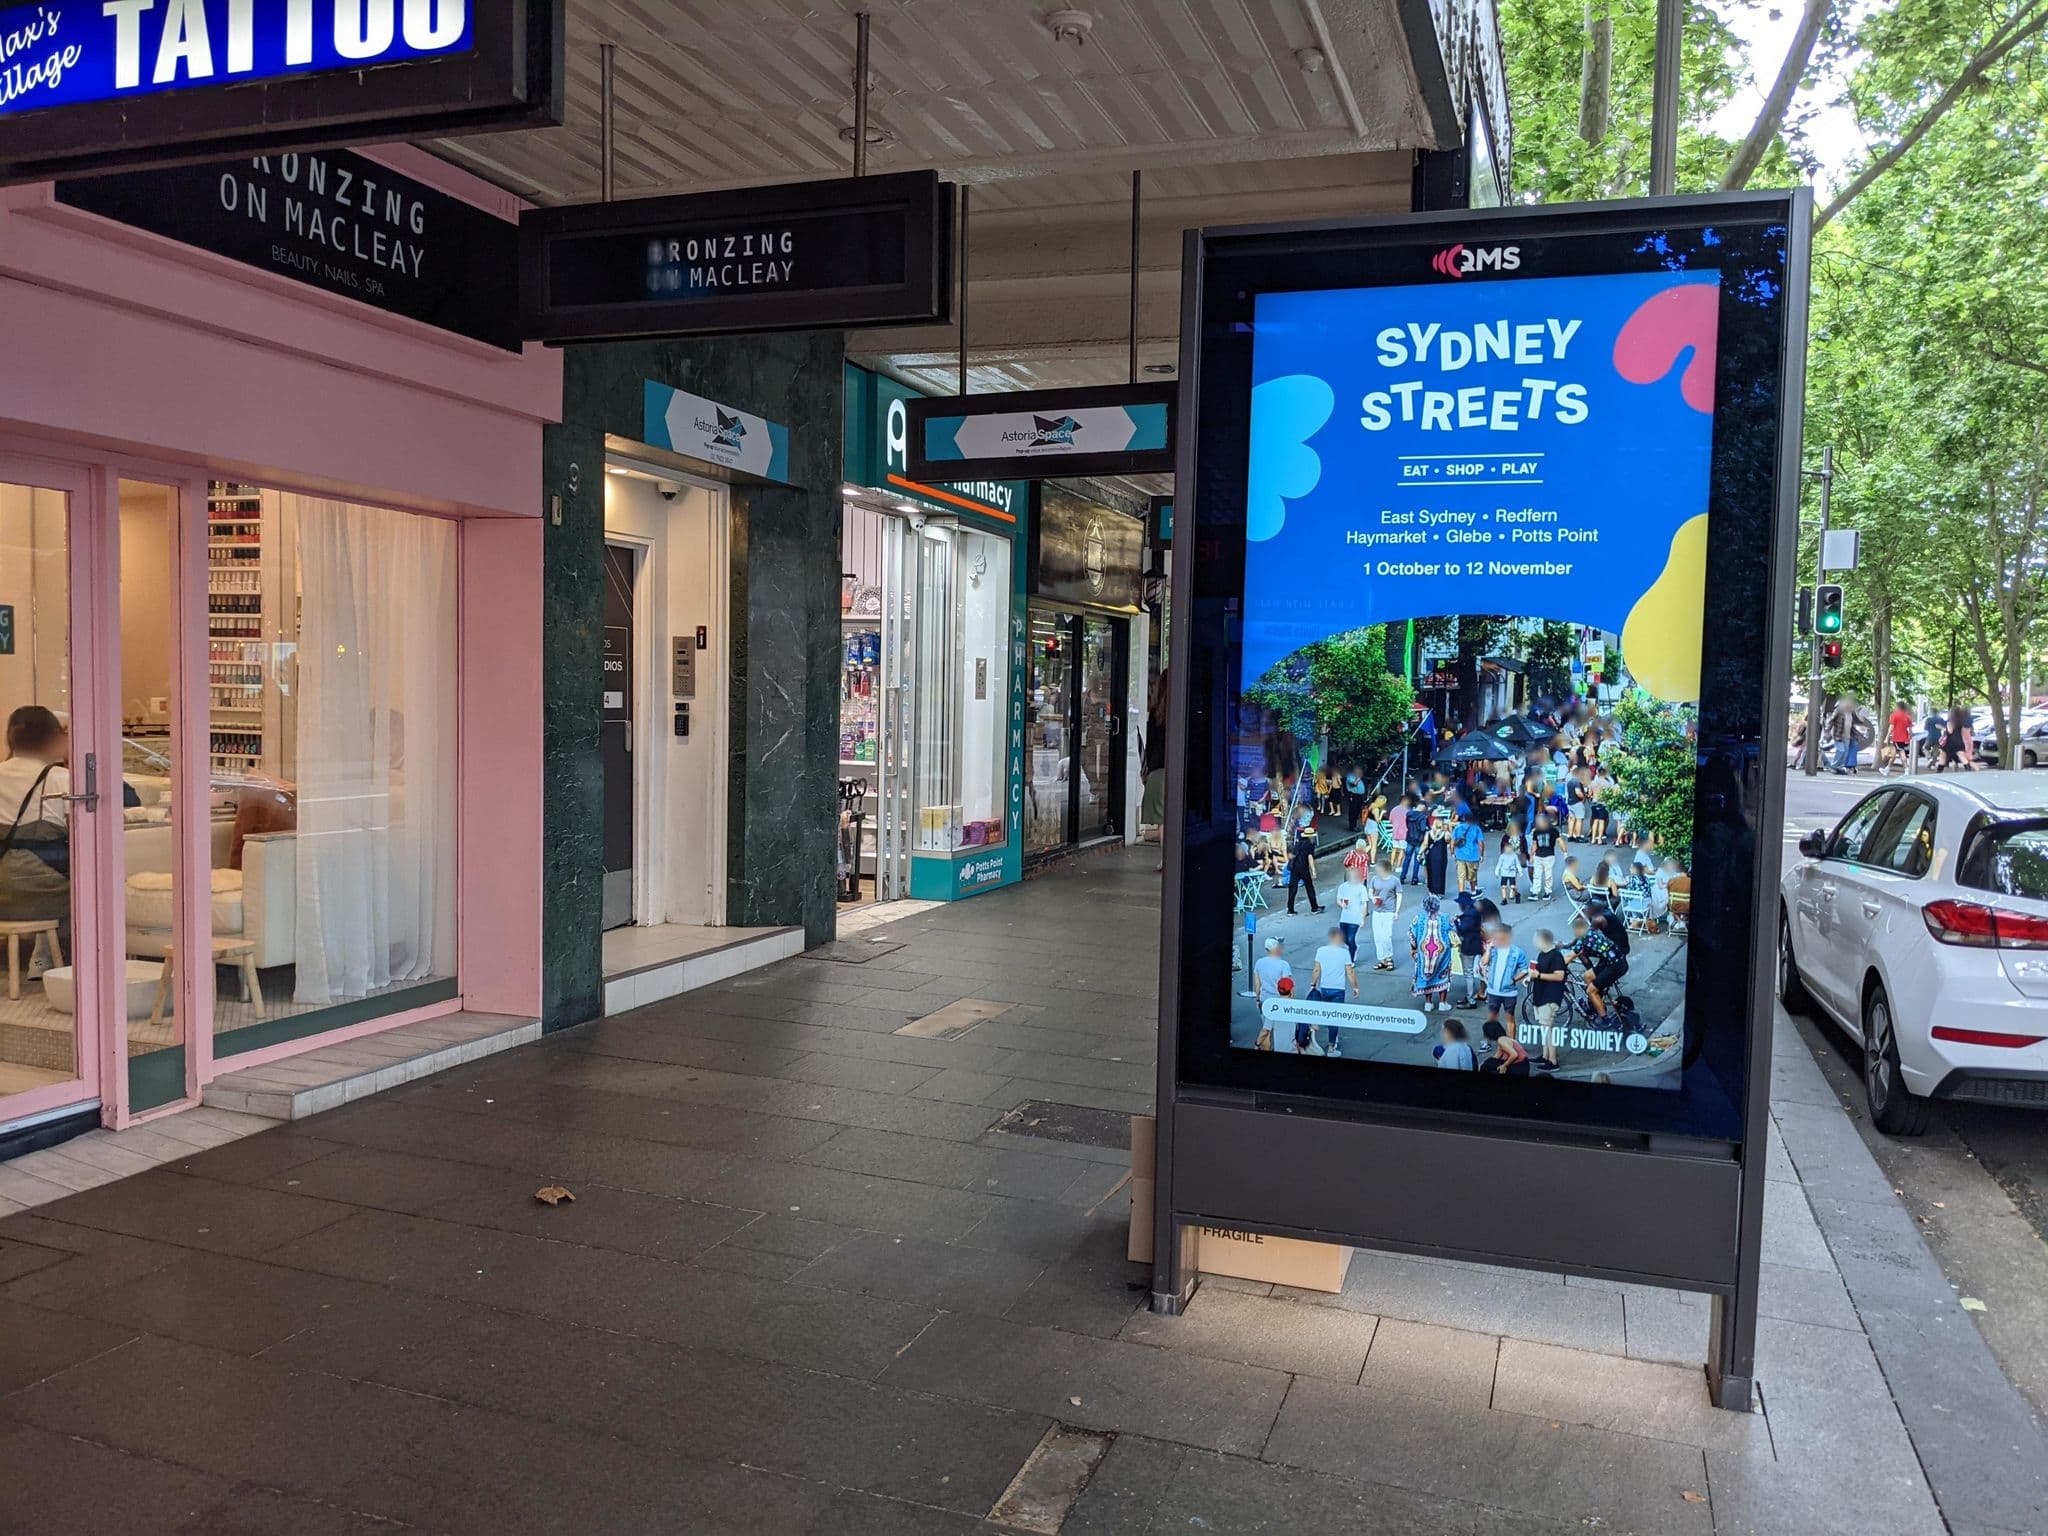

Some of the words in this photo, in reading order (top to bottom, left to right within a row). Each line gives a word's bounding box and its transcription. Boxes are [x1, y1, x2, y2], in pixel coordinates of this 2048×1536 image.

[0, 7, 61, 63] ax's
[103, 0, 465, 89] TATTOO
[219, 173, 267, 223] ON
[285, 196, 425, 279] MACLEAY
[648, 231, 793, 264] RONZING
[1446, 244, 1521, 278] QMS
[364, 277, 385, 296] SPA
[690, 260, 794, 288] MACLEAY
[1376, 318, 1583, 372] SYDNEY
[1360, 377, 1590, 432] STREETS
[1403, 464, 1430, 477] EAT
[1446, 463, 1485, 476] SHOP
[1501, 462, 1538, 475] PLAY
[944, 480, 1013, 512] armacy
[1380, 510, 1414, 525] East
[1418, 509, 1476, 527] Sydney
[1495, 508, 1558, 523] Redfern
[1346, 530, 1427, 547] Haymarket
[1446, 529, 1492, 543] Glebe
[1511, 528, 1553, 543] Potts
[1557, 527, 1599, 542] Point
[1363, 562, 1371, 575] 1
[1376, 561, 1441, 576] October
[1444, 563, 1461, 575] to
[1465, 562, 1484, 575] 12
[1488, 560, 1573, 575] November
[604, 660, 623, 671] DIOS
[1011, 619, 1023, 830] PHARMACY
[1283, 1005, 1416, 1026] whatson.sydney/sydneystreets
[1518, 1023, 1549, 1046] CITY
[1551, 1026, 1568, 1048] OF
[1570, 1028, 1624, 1052] SYDNEY
